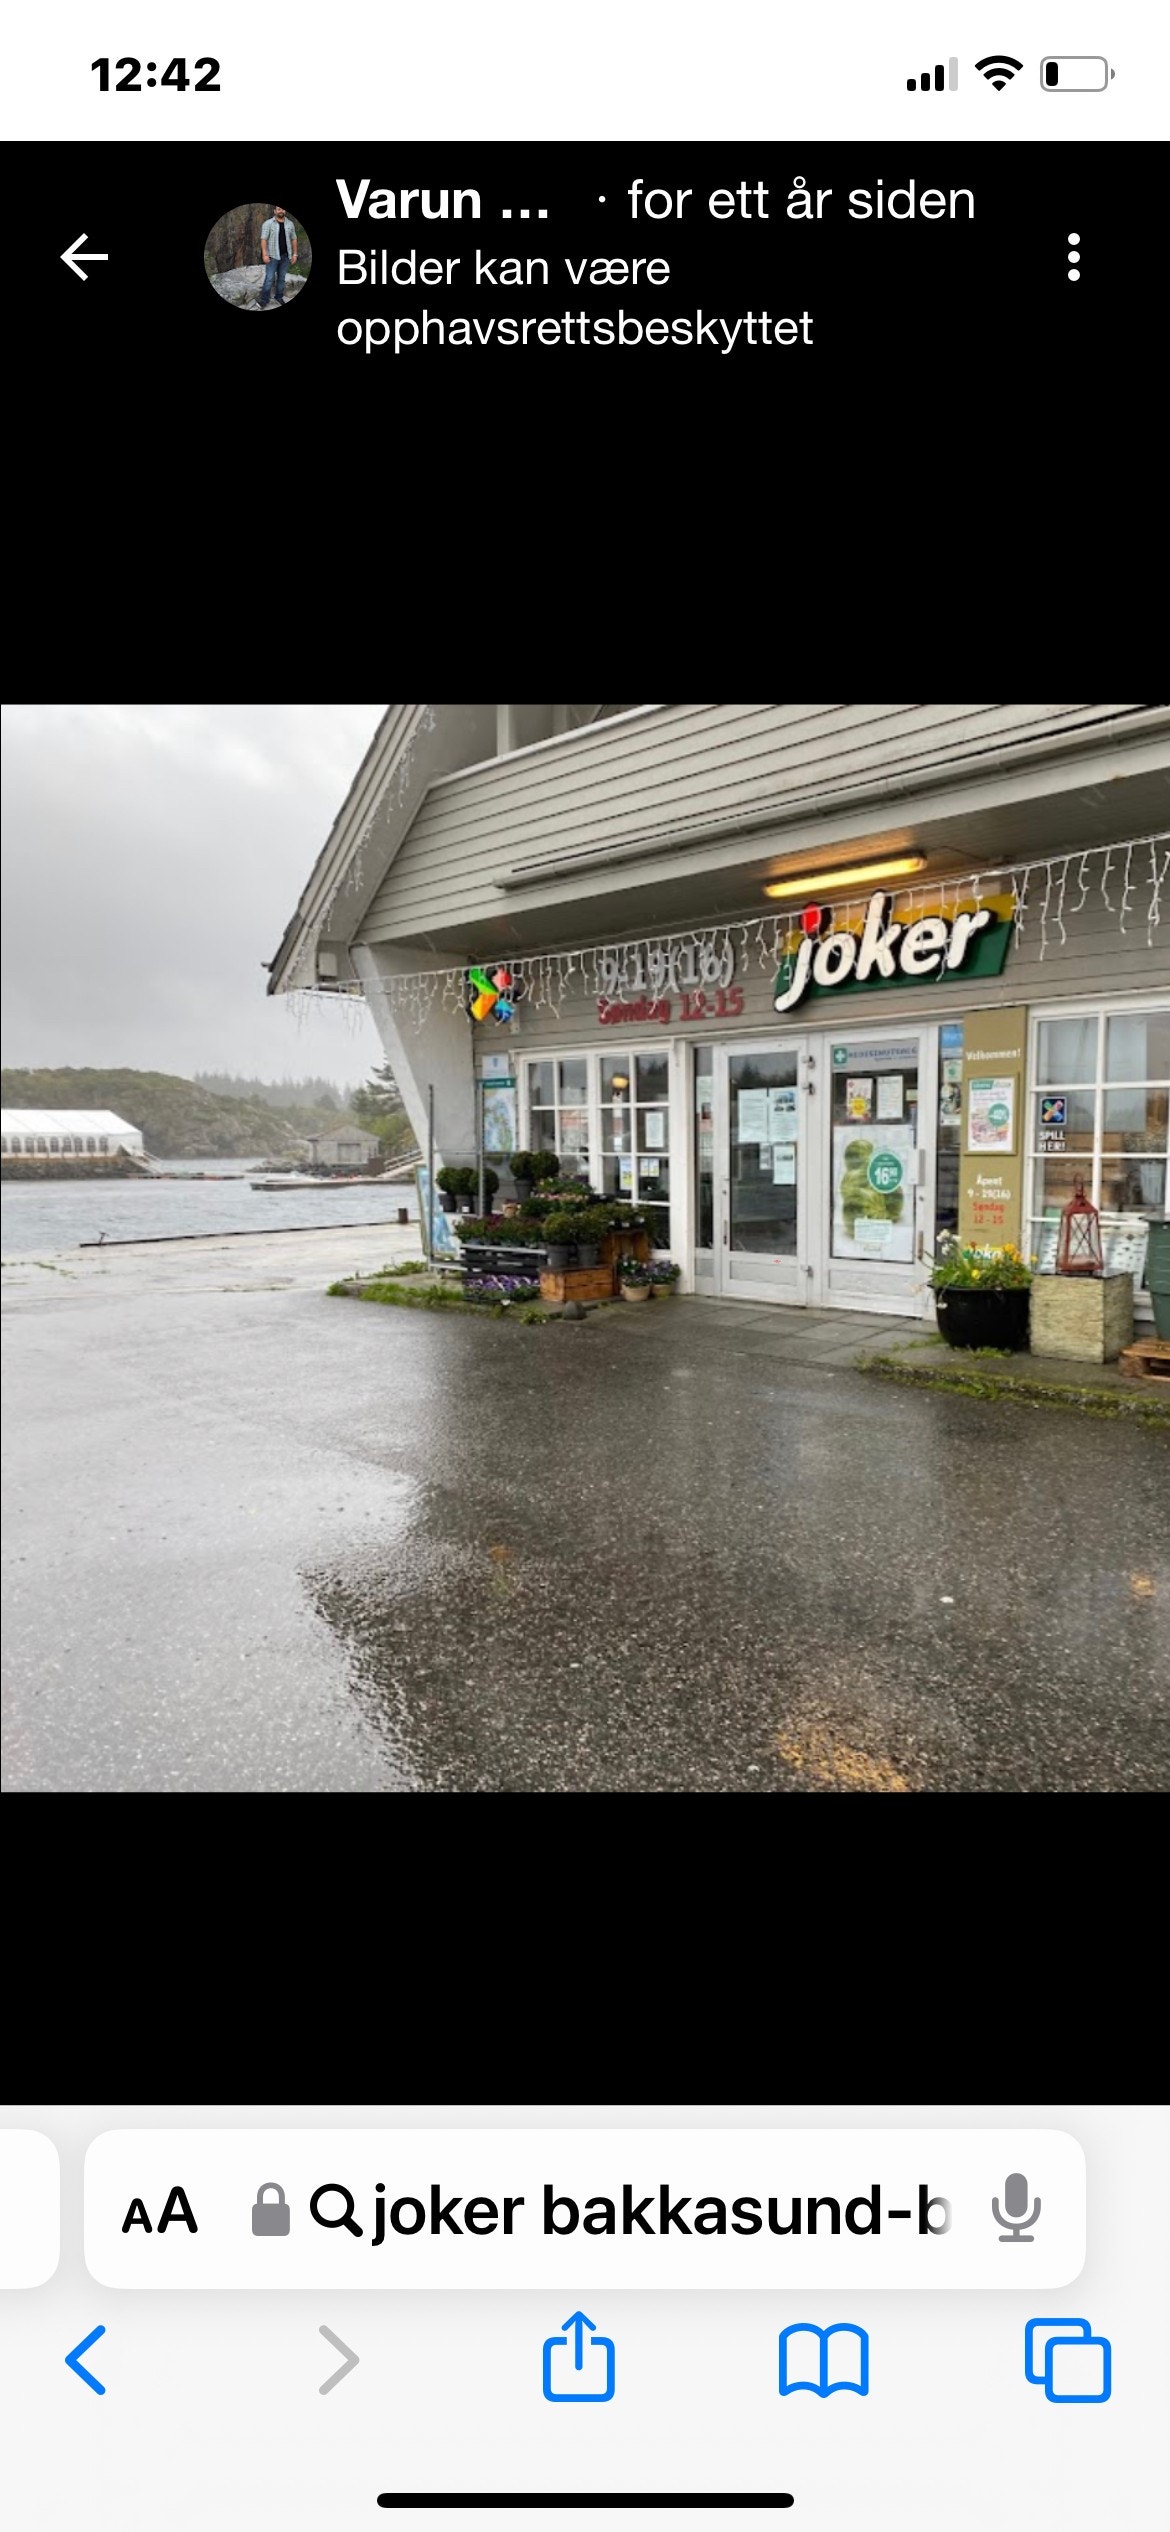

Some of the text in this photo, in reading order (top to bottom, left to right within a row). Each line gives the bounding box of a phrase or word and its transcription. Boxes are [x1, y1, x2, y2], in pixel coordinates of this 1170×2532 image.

[773, 892, 990, 1011] joker
[1039, 1130, 1066, 1140] SPILL
[1039, 1141, 1066, 1152] HER!
